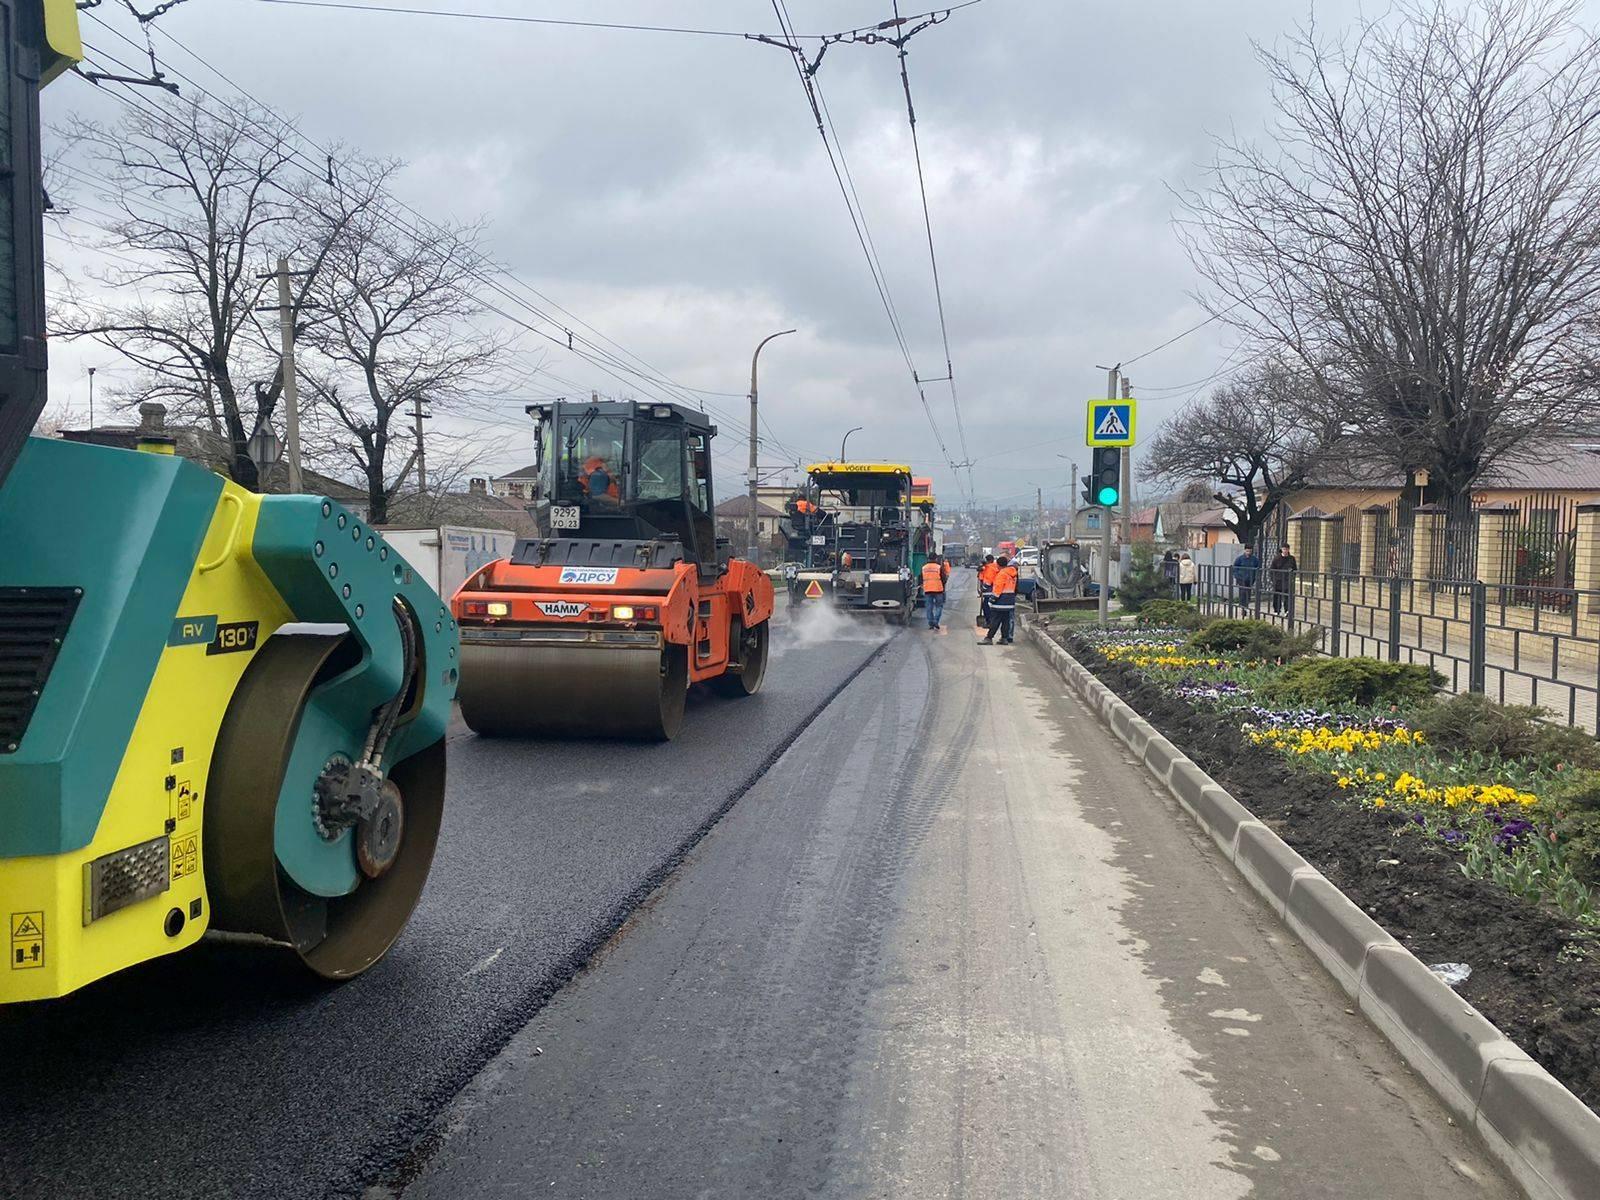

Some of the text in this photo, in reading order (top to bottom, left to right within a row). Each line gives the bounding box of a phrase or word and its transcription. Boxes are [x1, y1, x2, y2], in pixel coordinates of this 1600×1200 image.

[554, 507, 576, 517] 9292
[569, 520, 577, 528] 23
[576, 573, 615, 582] ДРСУ
[545, 604, 579, 614] HAMM
[183, 624, 203, 637] AV
